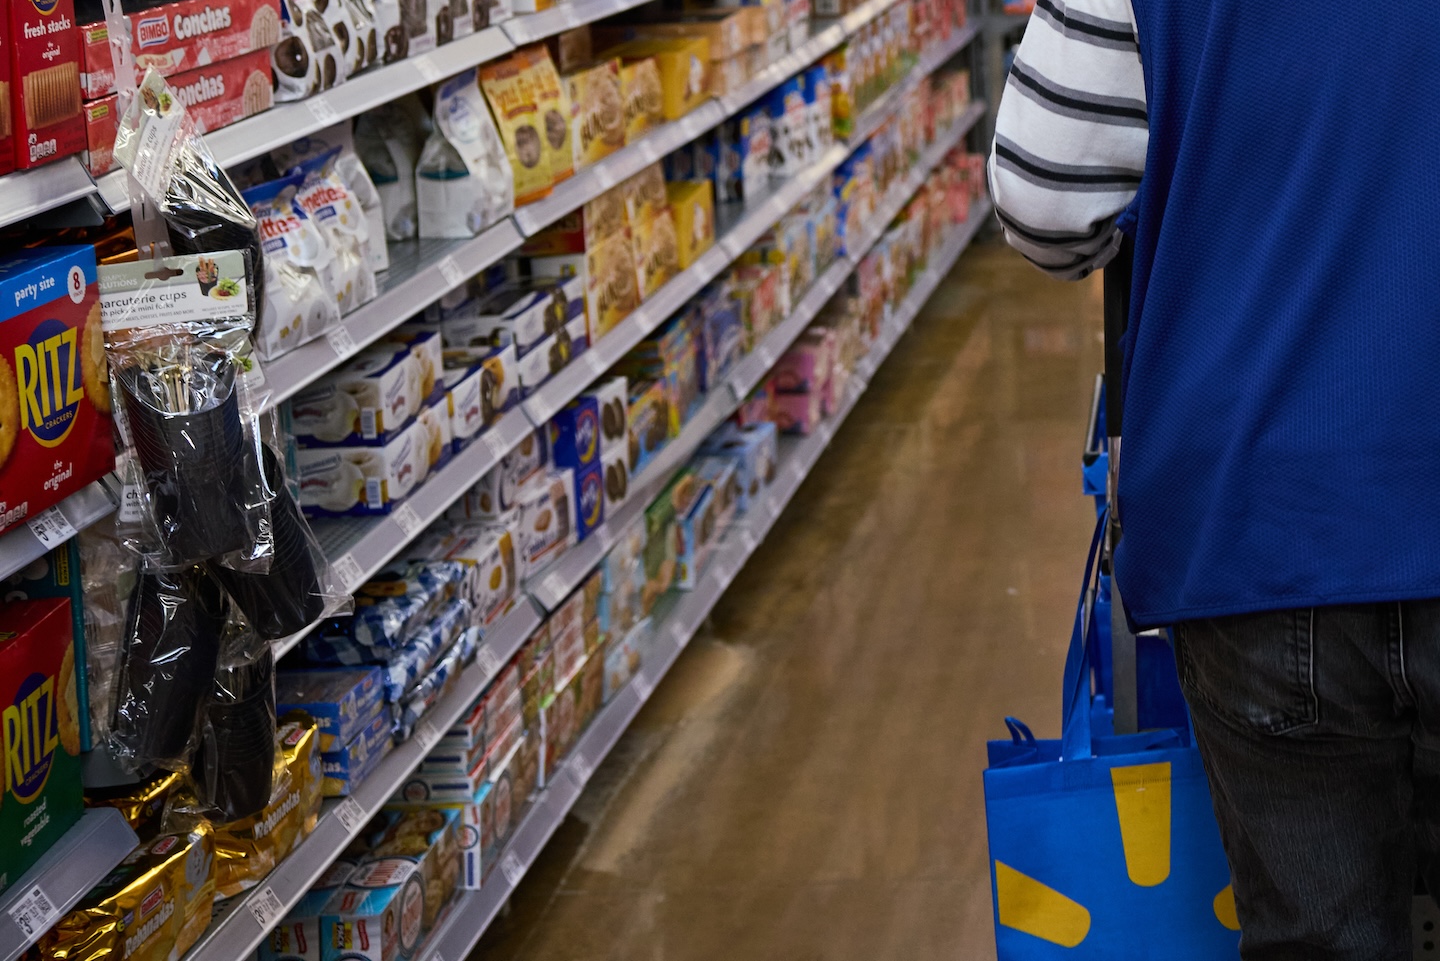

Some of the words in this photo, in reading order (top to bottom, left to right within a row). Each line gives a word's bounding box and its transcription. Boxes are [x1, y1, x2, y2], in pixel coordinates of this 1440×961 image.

[24, 21, 46, 40] fresh
[47, 15, 71, 34] stacks
[140, 23, 168, 41] BIMBO
[174, 6, 231, 40] Conchas
[42, 45, 61, 61] original
[14, 287, 38, 307] party
[39, 275, 55, 293] size
[73, 272, 80, 290] 8
[138, 304, 154, 312] mini
[160, 291, 187, 302] cups
[14, 326, 84, 430] RITZ
[45, 411, 73, 430] CRACKERS
[44, 462, 72, 490] original
[53, 460, 63, 470] the
[2, 675, 58, 792] RITZ
[24, 796, 47, 828] roasted
[254, 790, 300, 839] Rebanadas
[20, 815, 50, 847] vegetable
[141, 887, 163, 917] BIMBO
[124, 897, 175, 960] Rebanadas
